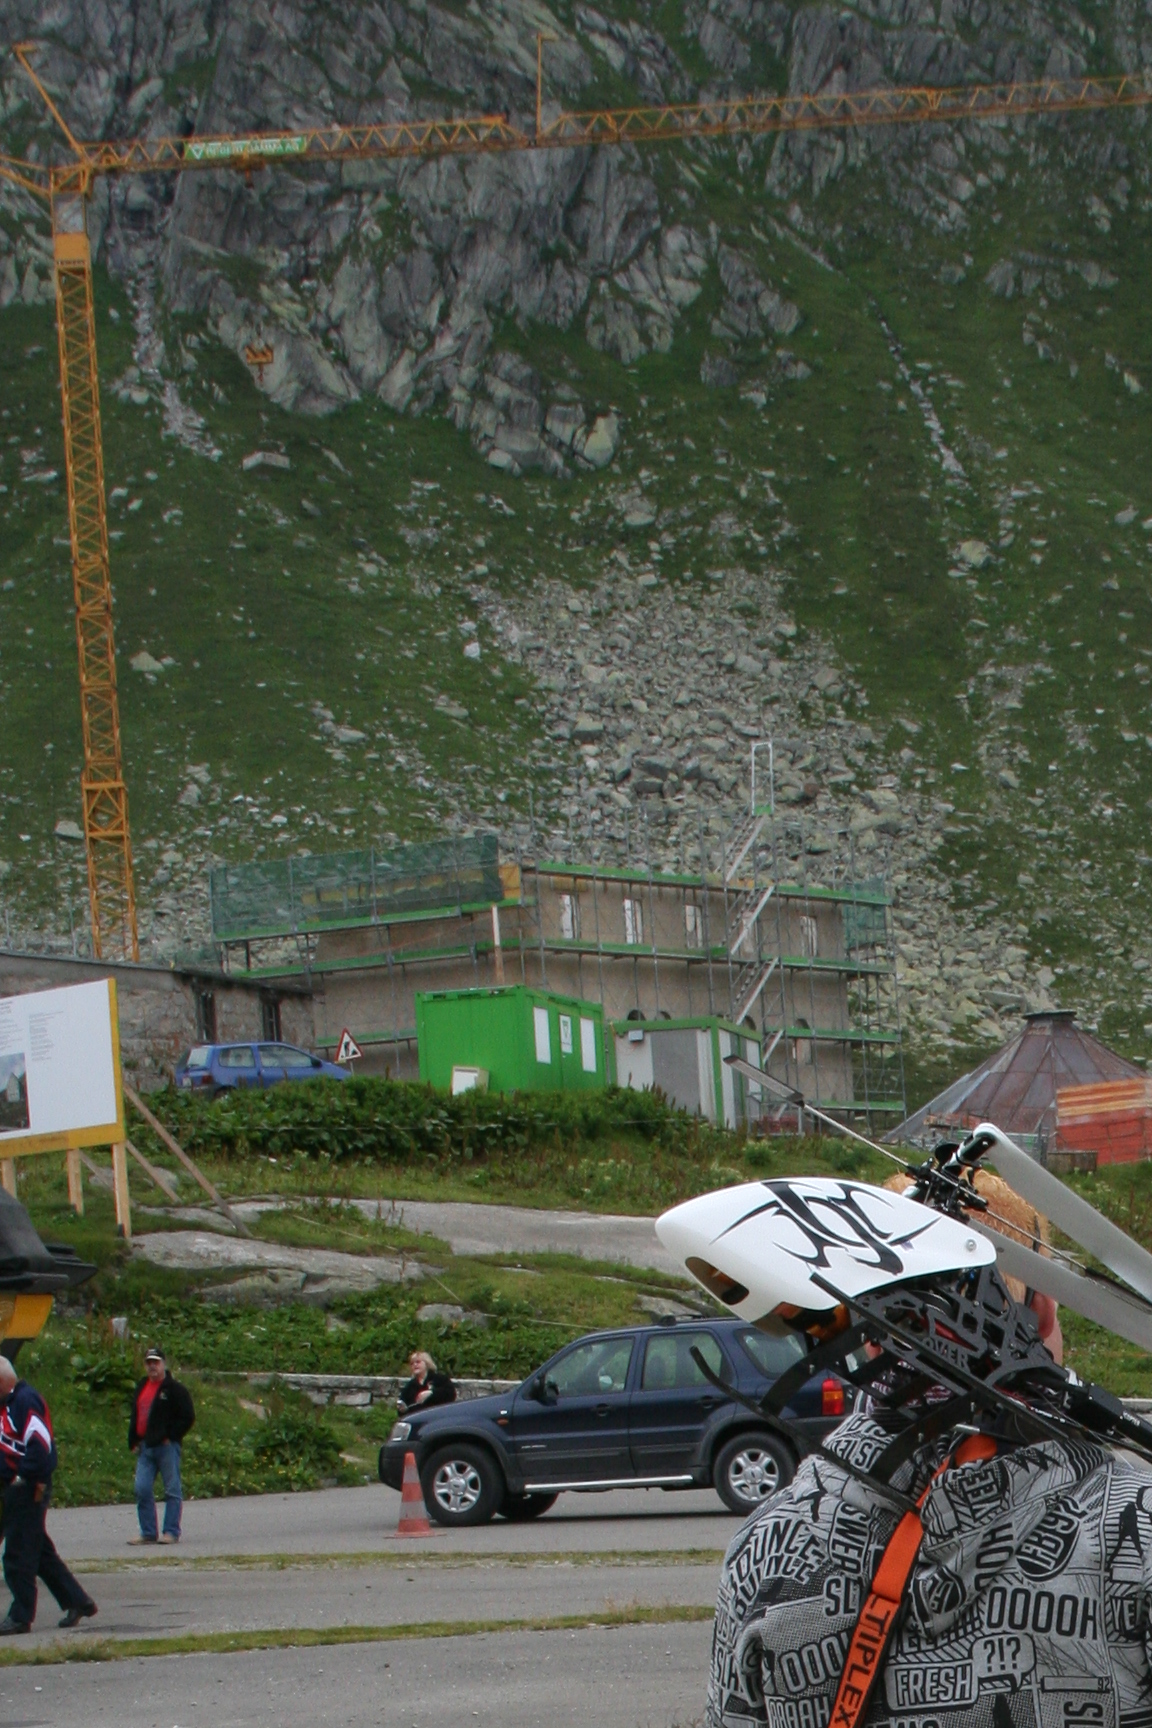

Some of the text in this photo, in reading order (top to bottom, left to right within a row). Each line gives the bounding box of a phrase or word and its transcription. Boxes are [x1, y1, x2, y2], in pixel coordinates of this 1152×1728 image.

[987, 1586, 1098, 1640] OOOOH
[983, 1636, 1021, 1671] ?!?
[897, 1665, 972, 1707] FRESH
